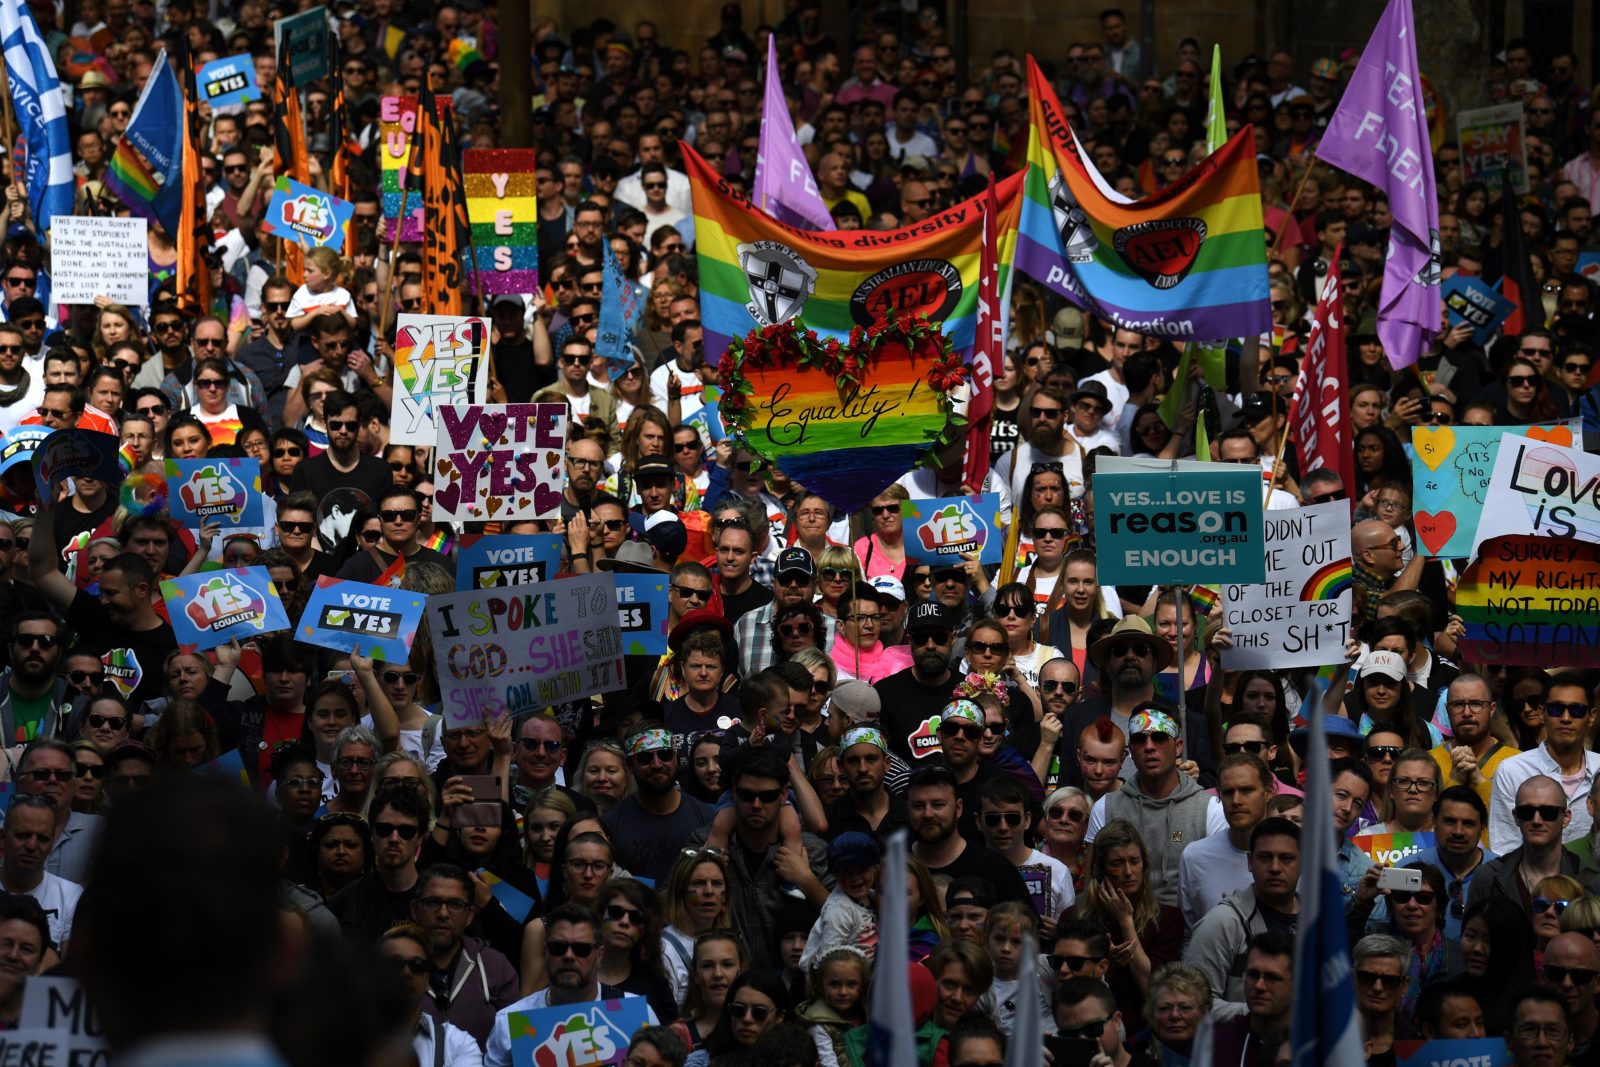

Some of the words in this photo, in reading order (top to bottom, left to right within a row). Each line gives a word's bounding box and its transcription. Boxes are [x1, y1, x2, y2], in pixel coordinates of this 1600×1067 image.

[208, 64, 236, 80] VOTE
[221, 75, 245, 91] YES
[1472, 123, 1511, 149] SAY
[133, 132, 170, 167] FIGHTING
[1466, 149, 1508, 173] YES
[109, 221, 138, 229] SURVEY
[292, 200, 329, 228] YES
[491, 173, 513, 271] YES
[92, 230, 130, 239] STUPIDEST
[292, 223, 322, 237] EQUALITY
[854, 208, 966, 247] diversity
[53, 249, 102, 257] GOVERNMENT
[98, 241, 142, 249] AUSTRALIAN
[1134, 230, 1194, 265] AEU
[853, 260, 917, 304] AUSTRALIAN
[872, 281, 946, 313] AEU
[1465, 285, 1497, 311] VOTE
[1463, 304, 1490, 325] YES
[1468, 451, 1490, 462] IT'S
[448, 450, 538, 503] YES
[1468, 467, 1484, 476] NO
[187, 476, 236, 504] YES
[1226, 490, 1246, 505] IS
[198, 504, 234, 515] EQUALITY
[1534, 498, 1576, 539] is
[926, 513, 977, 543] YES
[1109, 511, 1248, 533] reason
[1265, 513, 1318, 543] DIDN'T
[938, 542, 976, 554] EQUALITY
[1199, 534, 1248, 545] .org.au
[486, 547, 534, 565] VOTE
[1125, 548, 1236, 567] ENOUGH
[1302, 538, 1339, 566] OUT
[1499, 542, 1579, 563] SURVEY
[501, 568, 540, 587] YES
[1489, 570, 1521, 590] MY
[193, 585, 251, 619] YES
[341, 593, 391, 611] VOTE
[1228, 584, 1251, 602] OF
[1260, 580, 1294, 599] THE
[438, 604, 460, 638] I
[468, 592, 558, 636] SPOKE
[571, 586, 607, 618] TO
[1229, 605, 1296, 625] CLOSET
[1308, 602, 1339, 618] FOR
[1488, 597, 1535, 616] NOT
[213, 611, 255, 630] EQUALITY
[352, 612, 391, 634] YES
[1233, 632, 1269, 648] THIS
[1477, 621, 1600, 660] SATAN
[506, 682, 537, 711] COOL
[538, 670, 580, 702] WITH
[545, 1025, 616, 1067] YES
